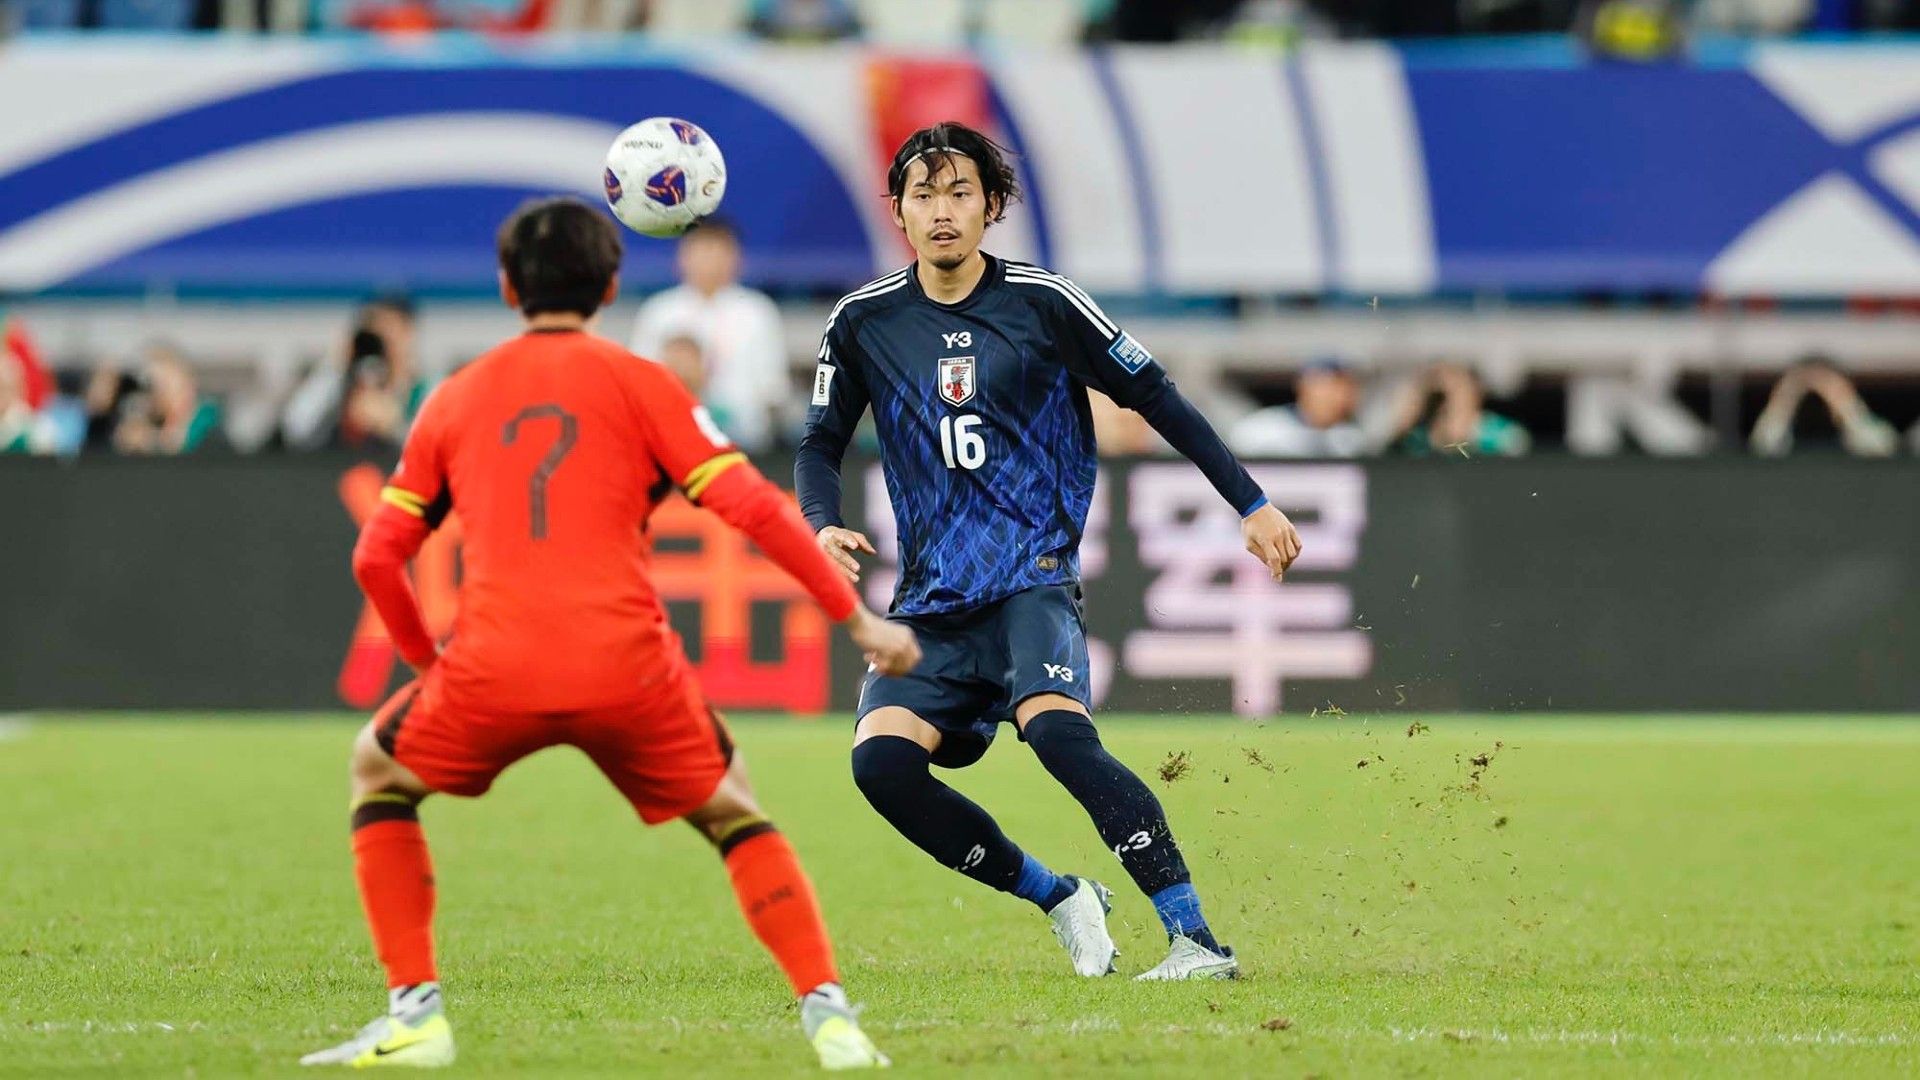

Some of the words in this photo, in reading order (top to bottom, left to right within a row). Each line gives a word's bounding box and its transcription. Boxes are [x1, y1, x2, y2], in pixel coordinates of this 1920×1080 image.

[941, 331, 973, 349] Y-3
[939, 414, 986, 470] 16
[502, 403, 578, 541] 7
[1042, 663, 1074, 683] Y-3
[954, 843, 986, 872] -3
